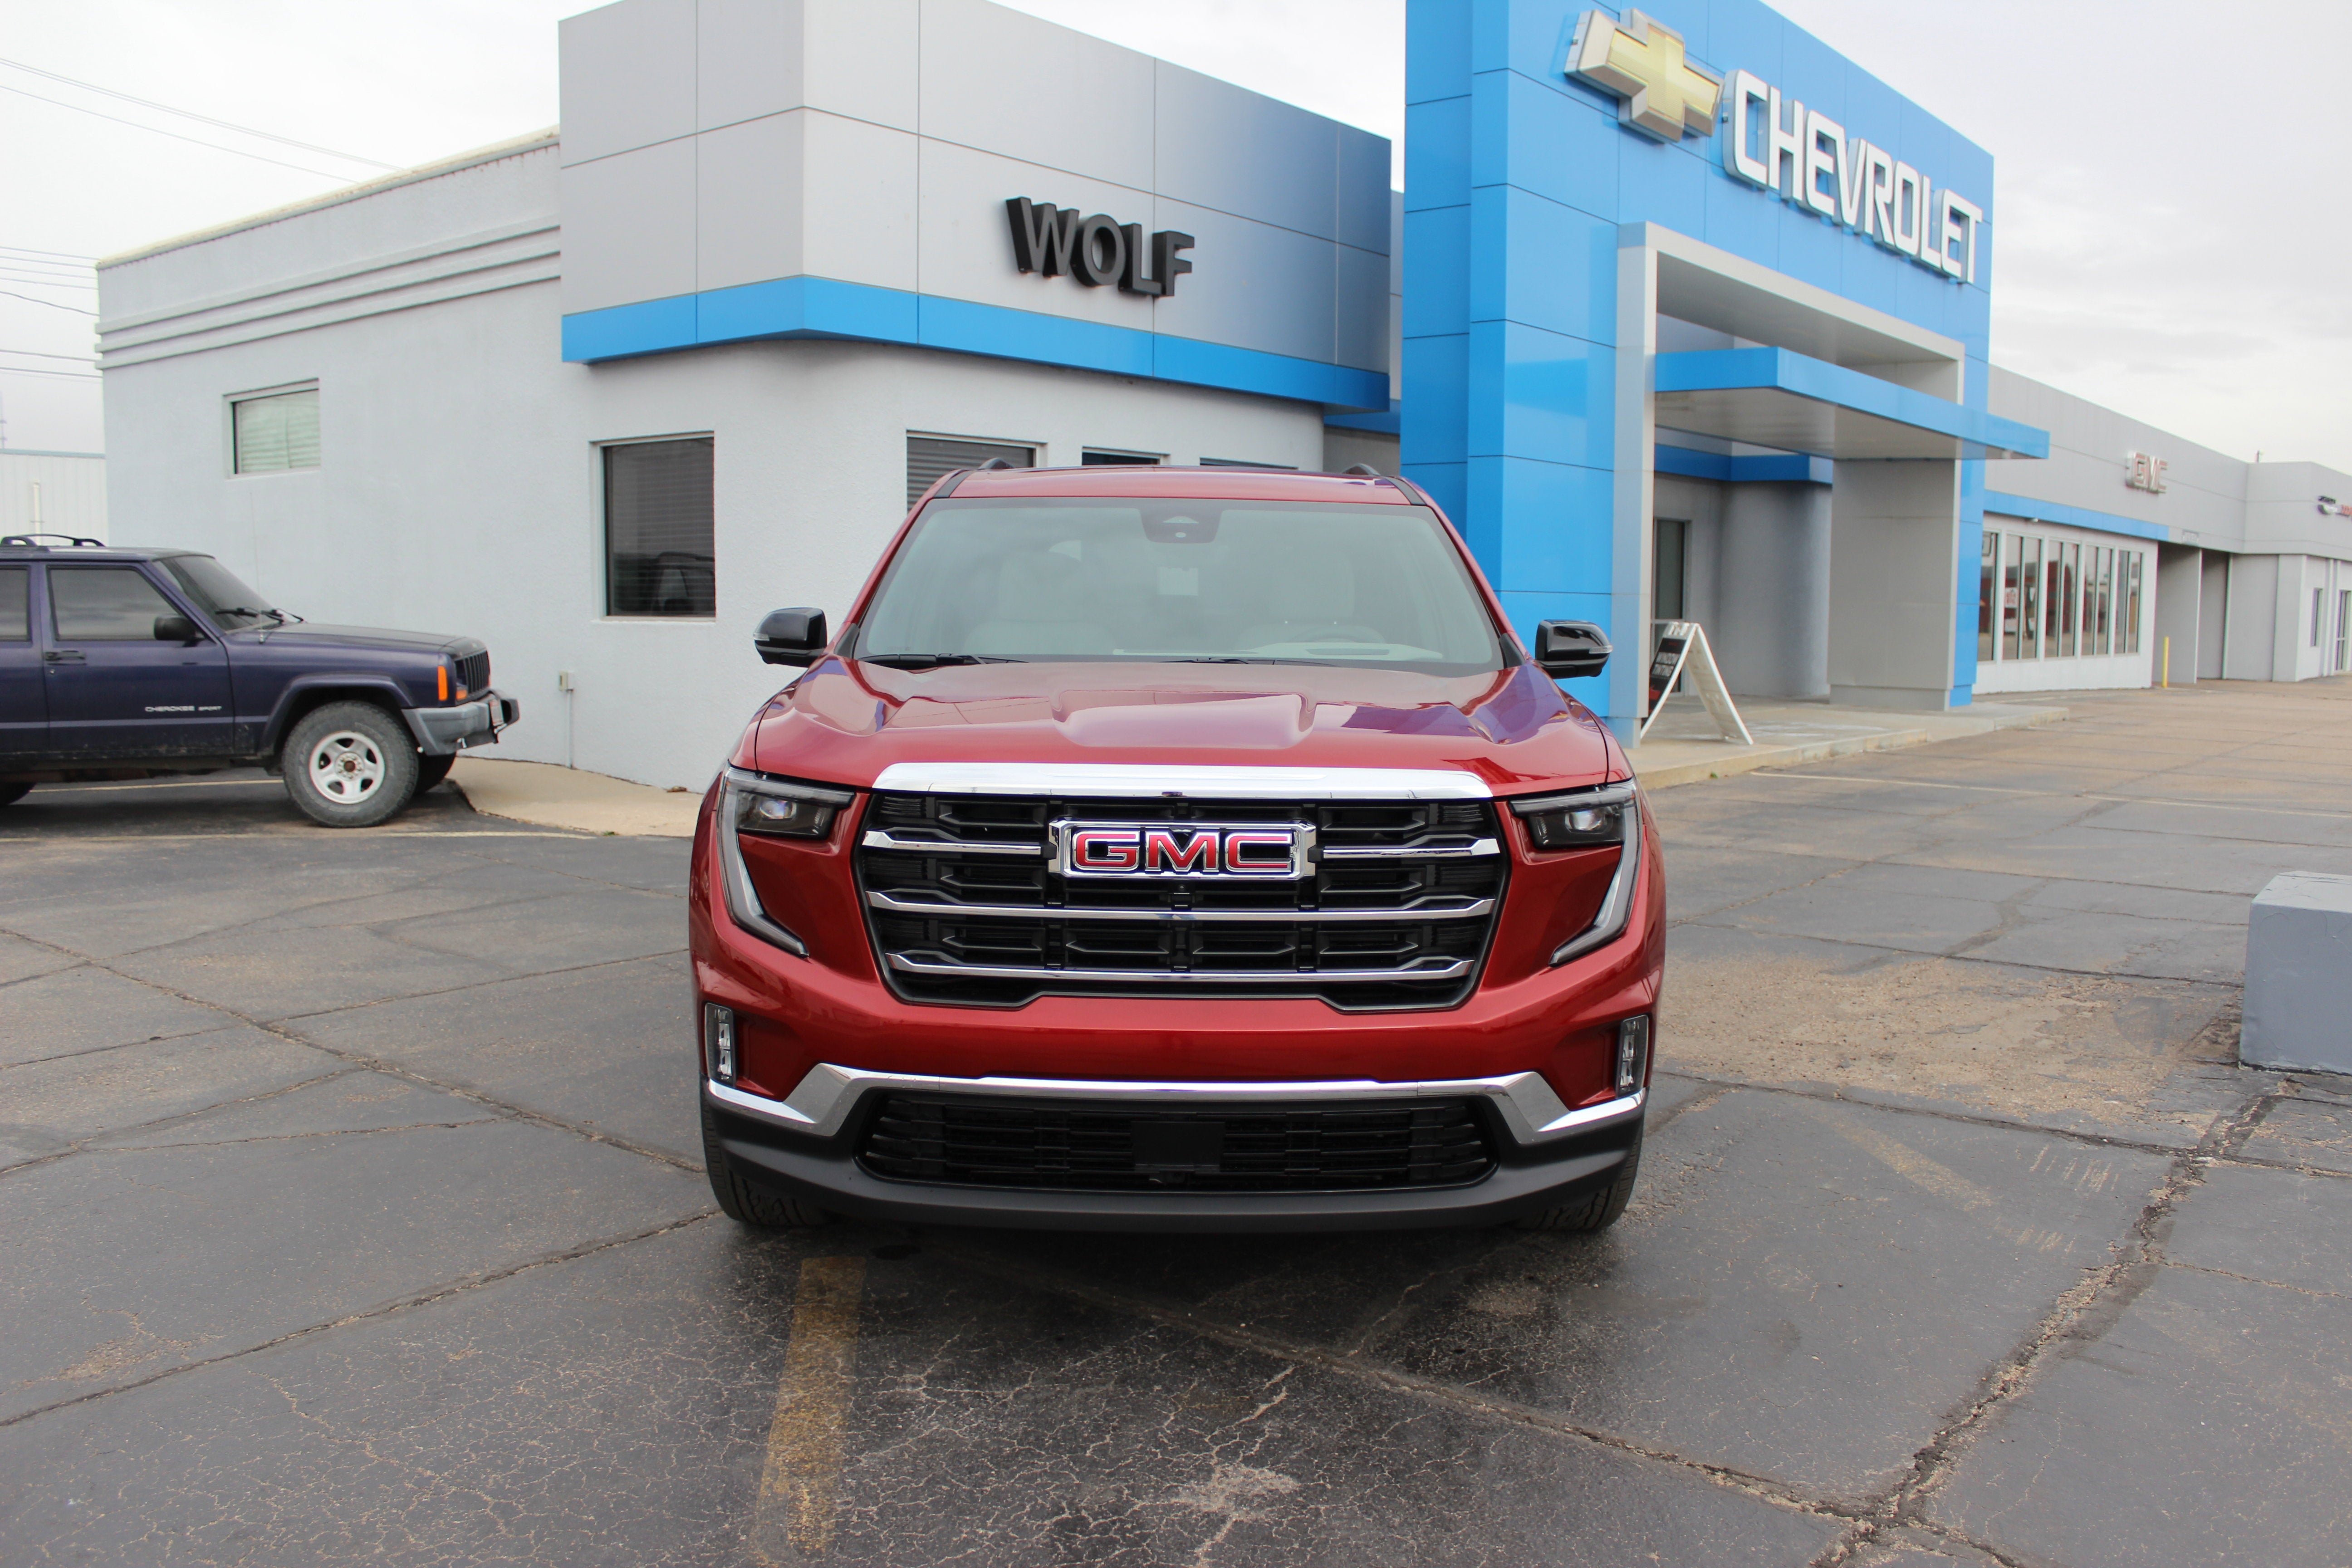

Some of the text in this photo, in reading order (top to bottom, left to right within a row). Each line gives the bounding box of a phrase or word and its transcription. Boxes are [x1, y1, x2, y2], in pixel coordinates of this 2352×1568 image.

[1724, 69, 1983, 284] CHEVROLET
[1005, 196, 1195, 297] WOLF
[2126, 451, 2168, 494] GMC
[1072, 830, 1293, 873] GMC
